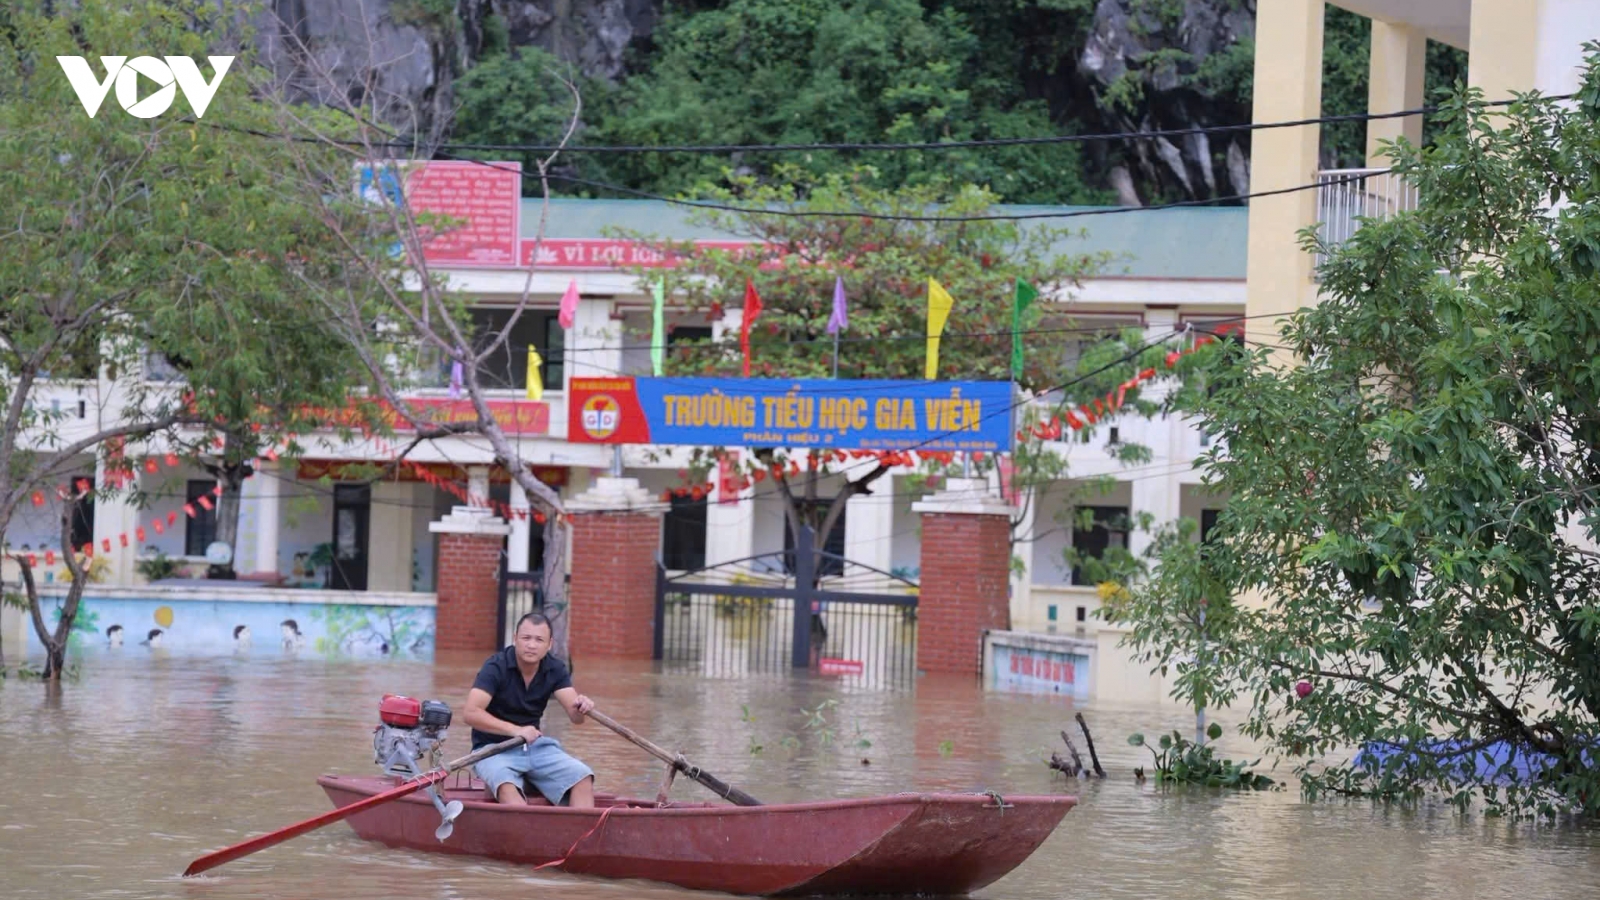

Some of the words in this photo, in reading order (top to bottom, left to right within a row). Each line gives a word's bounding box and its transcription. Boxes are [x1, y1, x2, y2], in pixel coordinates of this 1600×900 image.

[664, 389, 755, 427] TRƯỜNG
[819, 398, 868, 435] HỌC
[876, 398, 916, 430] GIA
[924, 388, 981, 431] VIỄN
